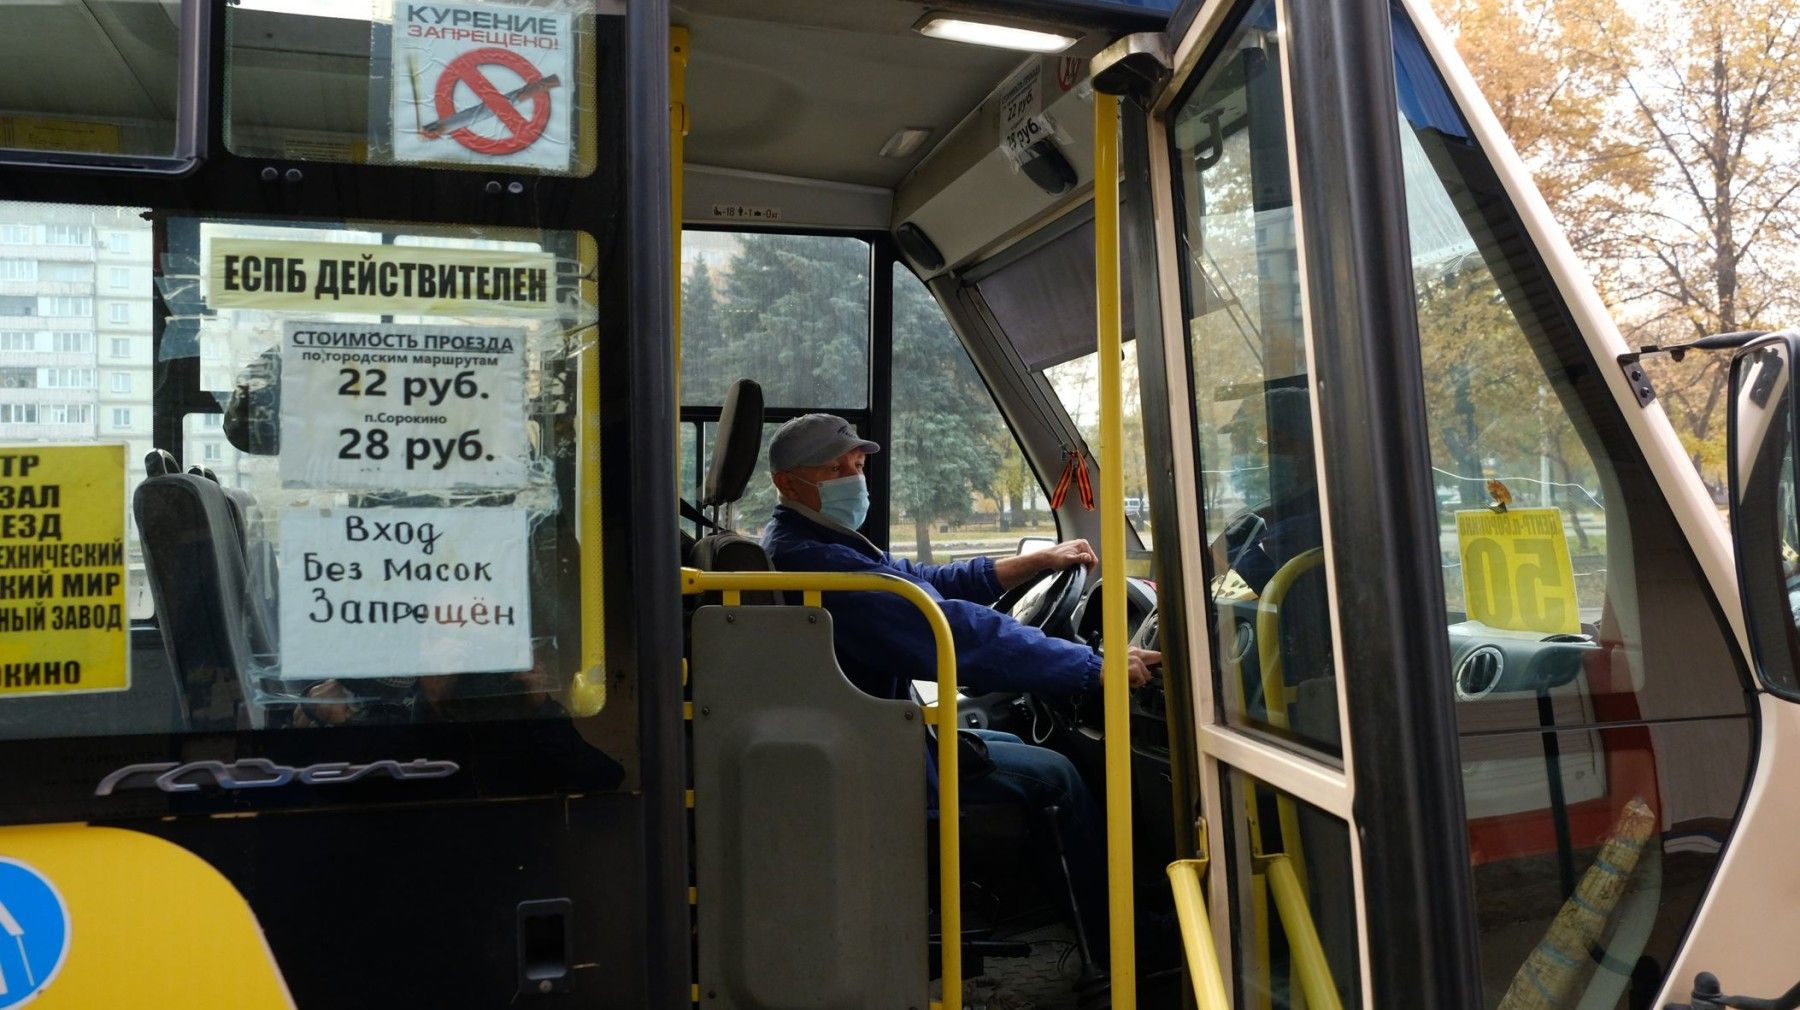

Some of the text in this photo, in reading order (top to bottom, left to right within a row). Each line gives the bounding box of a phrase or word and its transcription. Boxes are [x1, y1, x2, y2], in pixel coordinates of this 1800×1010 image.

[407, 5, 557, 36] КУРЕНИЕ
[407, 25, 558, 49] ЗАПРЕЩЕНО!
[224, 254, 547, 302] ЕСПБ ДЕЙСТВИТЕЛЕН
[293, 331, 513, 352] СТОИМОСТЬ ПРОЕЗДА
[302, 351, 498, 368] по городским маршрутам
[337, 368, 489, 406] 22 руб.
[364, 413, 447, 426] п.Сорокино
[338, 428, 494, 470] 28 руб.
[0, 455, 40, 477] ТР
[2, 514, 63, 541] ЕЗД
[345, 515, 443, 555] Вход
[303, 552, 363, 582] Без
[62, 572, 121, 598] МИР
[52, 604, 122, 632] ЗАВОД
[309, 588, 515, 628] Запрещён
[0, 660, 80, 688] КИНО
